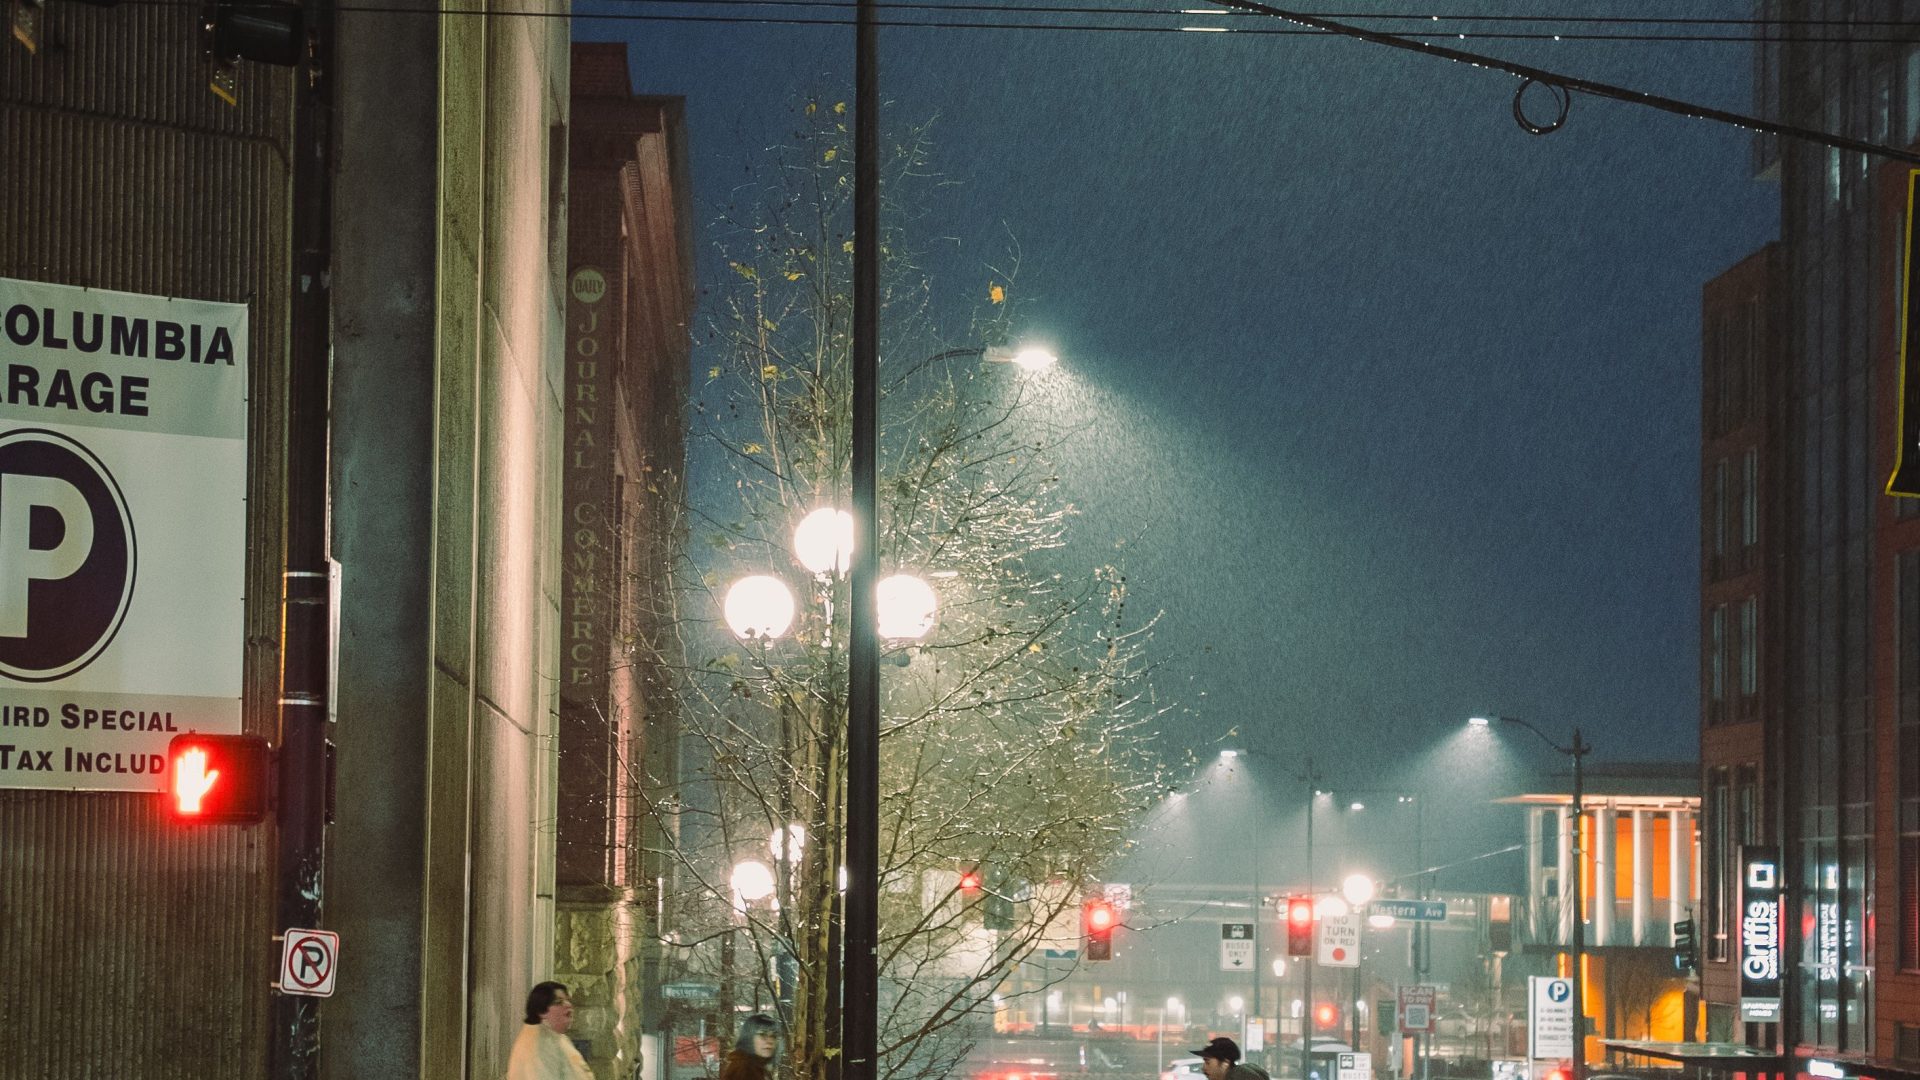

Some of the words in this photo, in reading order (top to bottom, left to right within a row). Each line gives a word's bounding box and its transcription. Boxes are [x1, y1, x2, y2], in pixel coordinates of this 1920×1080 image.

[574, 279, 603, 295] DAILY
[0, 304, 235, 367] OLUMBIA
[0, 364, 150, 417] RAGE
[574, 311, 599, 469] JOURNAL
[571, 502, 597, 685] COMMERCE
[60, 703, 178, 733] SPECIAL
[0, 744, 54, 772] TAX
[1370, 903, 1416, 917] Western
[1425, 906, 1443, 918] Ave
[1332, 915, 1349, 925] NO
[1326, 926, 1356, 937] TURN
[1225, 942, 1250, 950] BUSES
[1324, 937, 1336, 945] ON
[1339, 938, 1356, 946] RED
[1743, 901, 1769, 979] Griffis
[1402, 987, 1434, 996] SCAN
[1416, 996, 1433, 1004] PAY
